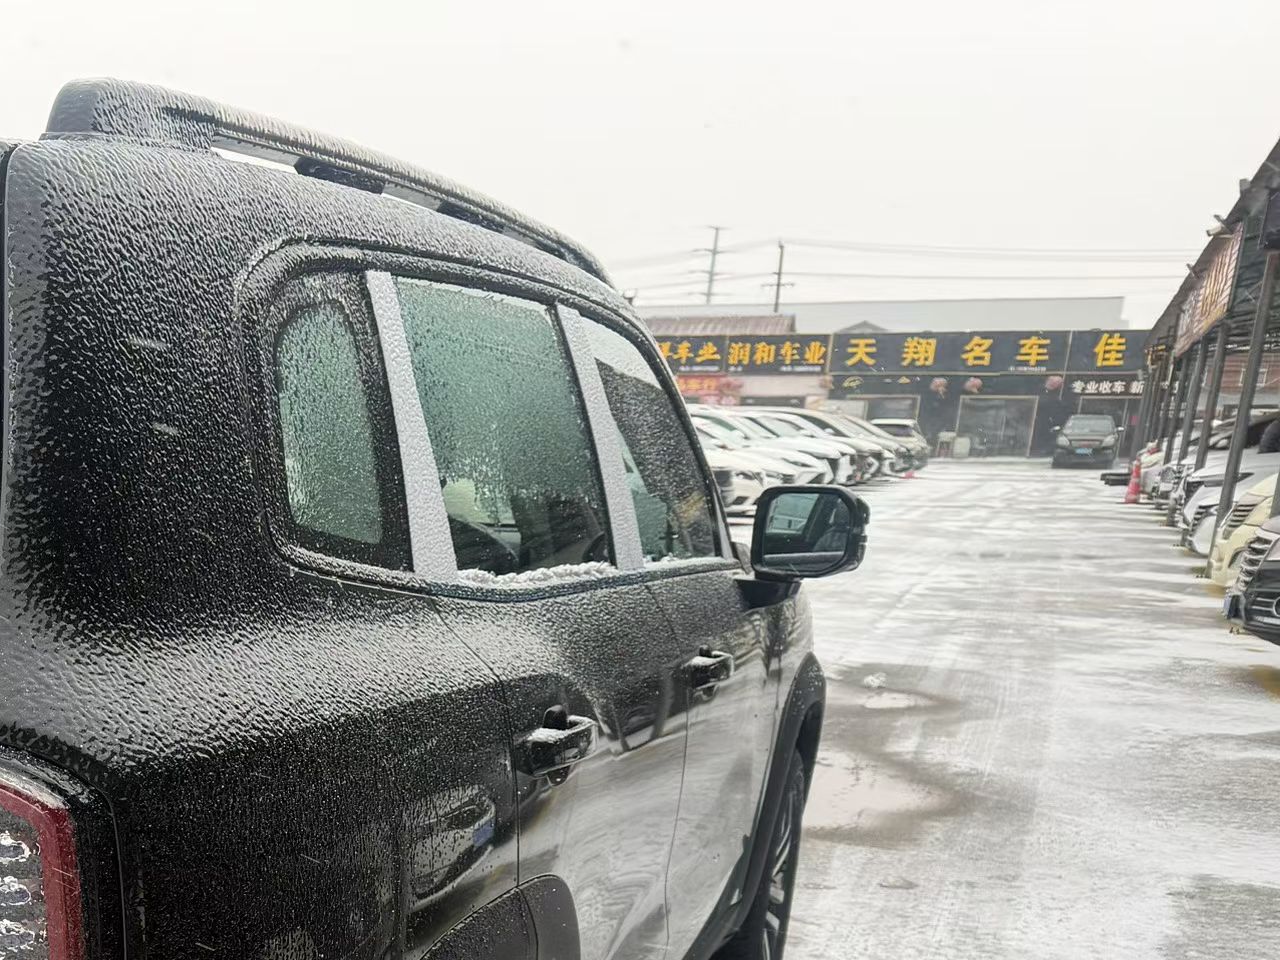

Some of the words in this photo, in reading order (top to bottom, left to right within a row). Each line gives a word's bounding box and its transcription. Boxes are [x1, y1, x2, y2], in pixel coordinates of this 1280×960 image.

[728, 341, 826, 366] 润和车业
[846, 336, 1051, 367] 天翔名车
